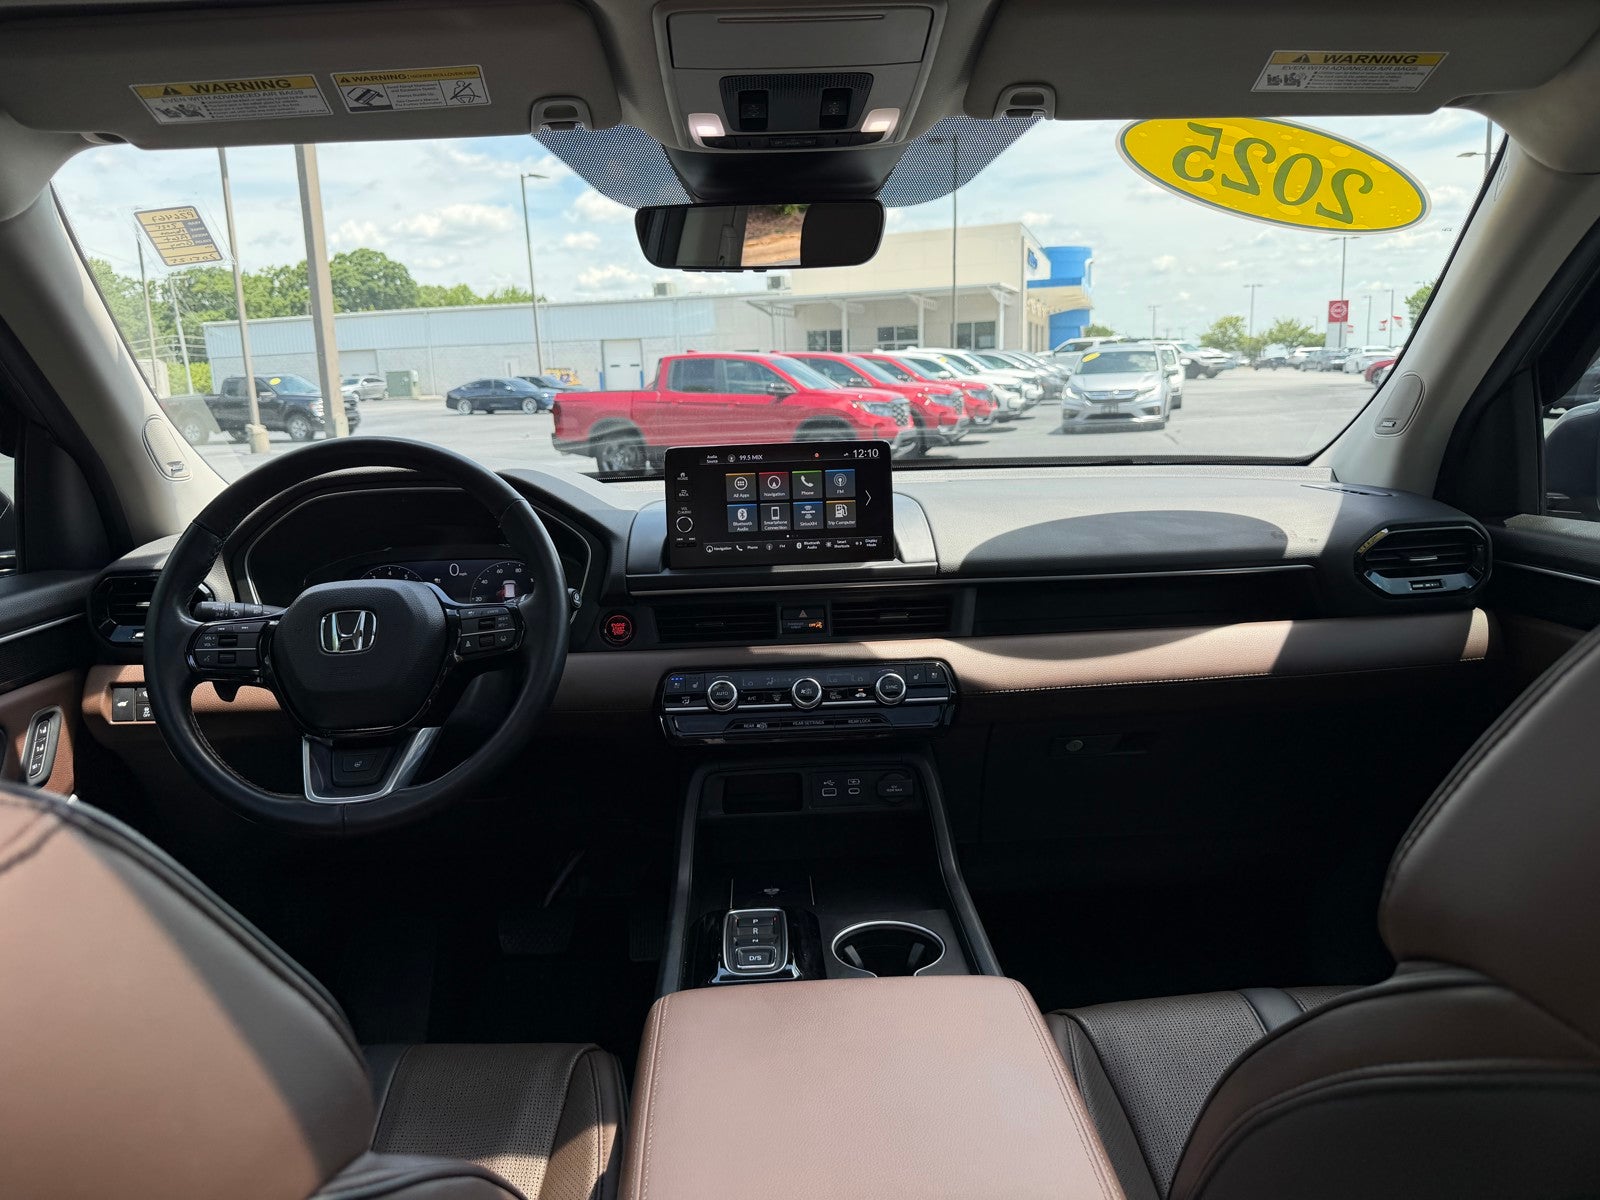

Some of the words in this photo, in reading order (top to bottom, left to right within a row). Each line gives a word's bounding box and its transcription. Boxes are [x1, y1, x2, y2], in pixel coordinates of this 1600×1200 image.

[1321, 54, 1420, 64] WARNING
[188, 79, 292, 96] WARNING
[206, 93, 262, 101] ADVANCED
[852, 448, 879, 458] 12:10
[449, 563, 460, 577] 0
[752, 927, 759, 935] R
